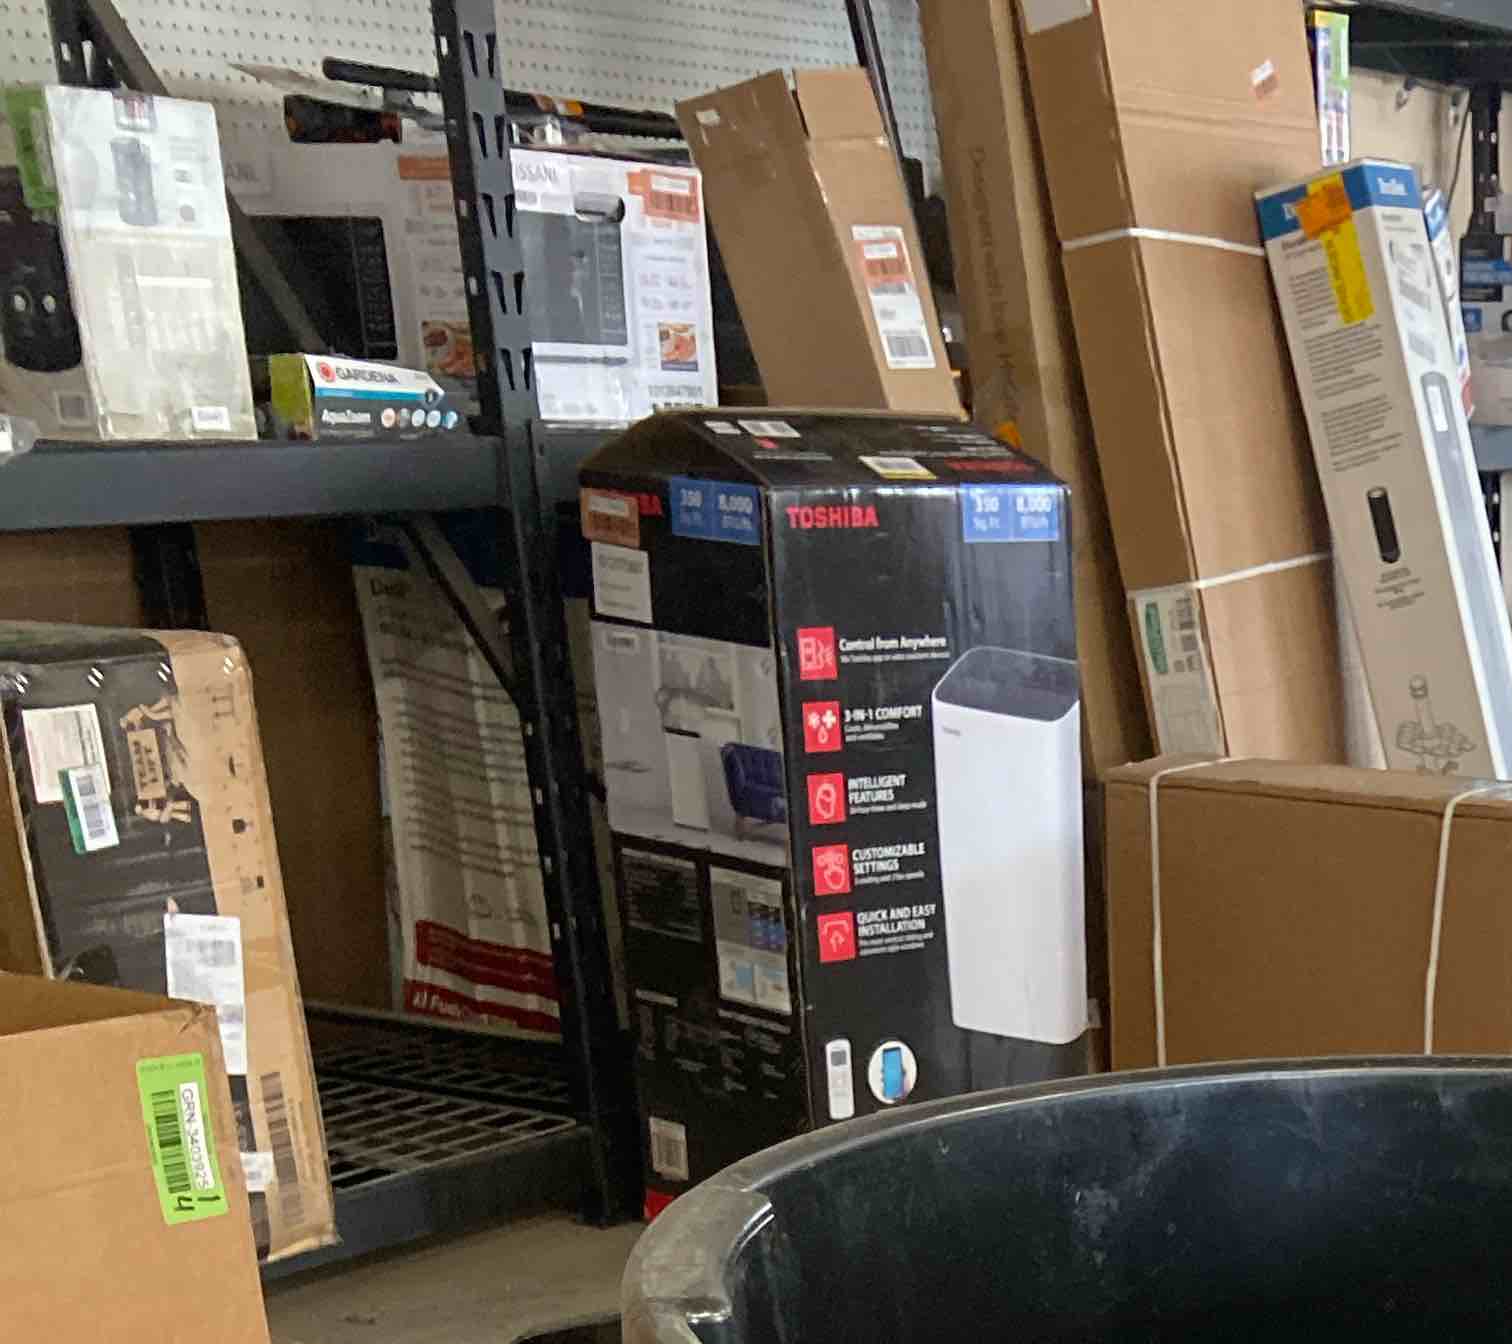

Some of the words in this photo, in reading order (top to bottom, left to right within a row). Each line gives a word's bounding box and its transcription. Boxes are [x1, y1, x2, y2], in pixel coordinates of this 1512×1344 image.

[336, 367, 400, 384] GARDENA
[785, 505, 880, 529] TOSHIBA
[875, 705, 922, 721] COMFORT
[848, 774, 906, 791] INTELLIGENT
[850, 788, 895, 804] FEATURES
[852, 842, 925, 862] CUSTOMIZABLE
[853, 858, 900, 876] SETTINGS
[856, 908, 888, 925] QUICK
[890, 905, 911, 919] AND
[858, 918, 926, 937] INSTALLATION
[182, 1088, 196, 1124] GRN
